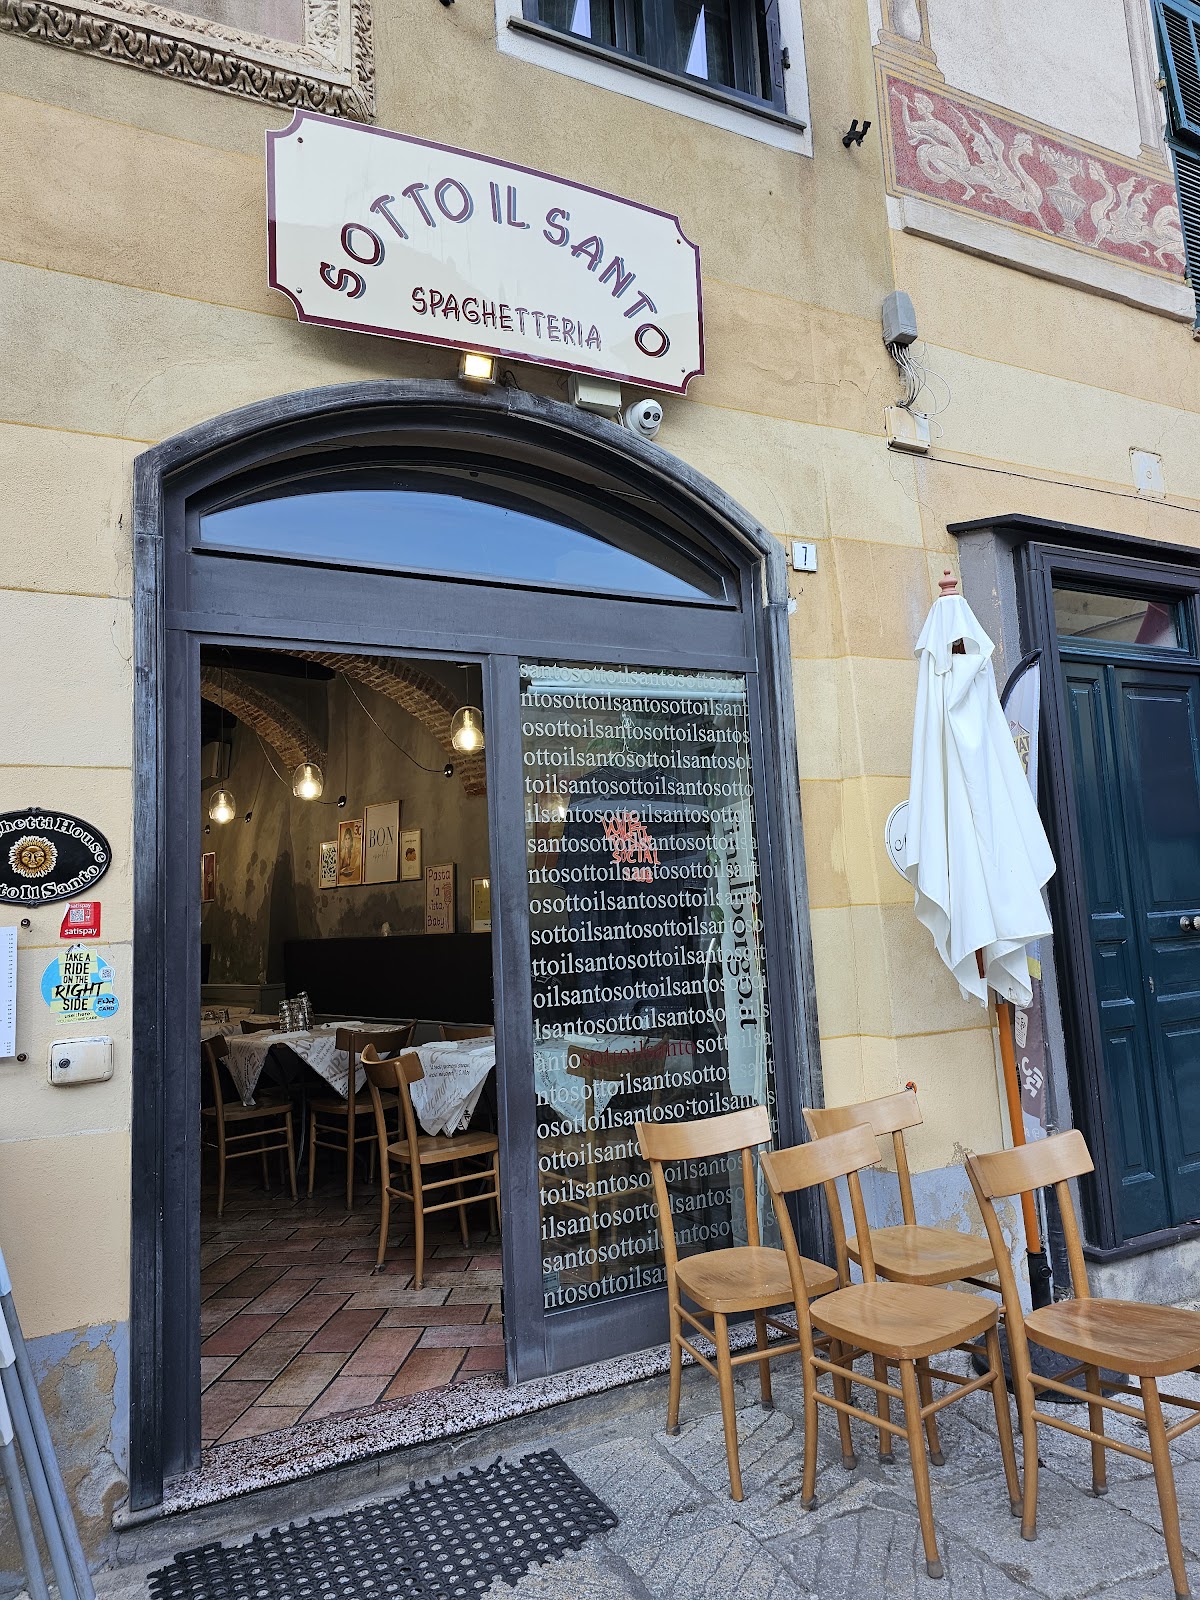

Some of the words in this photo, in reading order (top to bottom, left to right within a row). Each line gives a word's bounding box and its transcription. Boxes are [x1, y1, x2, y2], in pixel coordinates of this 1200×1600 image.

[319, 177, 474, 300] SOTTO
[489, 181, 530, 230] IL
[543, 207, 671, 358] SANTO
[411, 286, 603, 352] SPAGHETTERIA
[801, 545, 808, 566] 7
[525, 773, 754, 797] toilsantosottoilsantosotto
[0, 817, 53, 838] hetti
[54, 818, 107, 863] House
[369, 826, 395, 848] BON
[20, 884, 40, 899] Il
[42, 865, 100, 899] Santo
[428, 868, 451, 882] Pasta
[64, 927, 98, 936] satispay
[427, 915, 446, 929] Baby
[65, 952, 84, 962] TAKE
[85, 953, 91, 962] A
[64, 962, 90, 975] RIDE
[63, 975, 73, 984] ON
[75, 975, 89, 983] THE
[54, 981, 104, 1001] RIGHT
[63, 998, 88, 1011] SIDE
